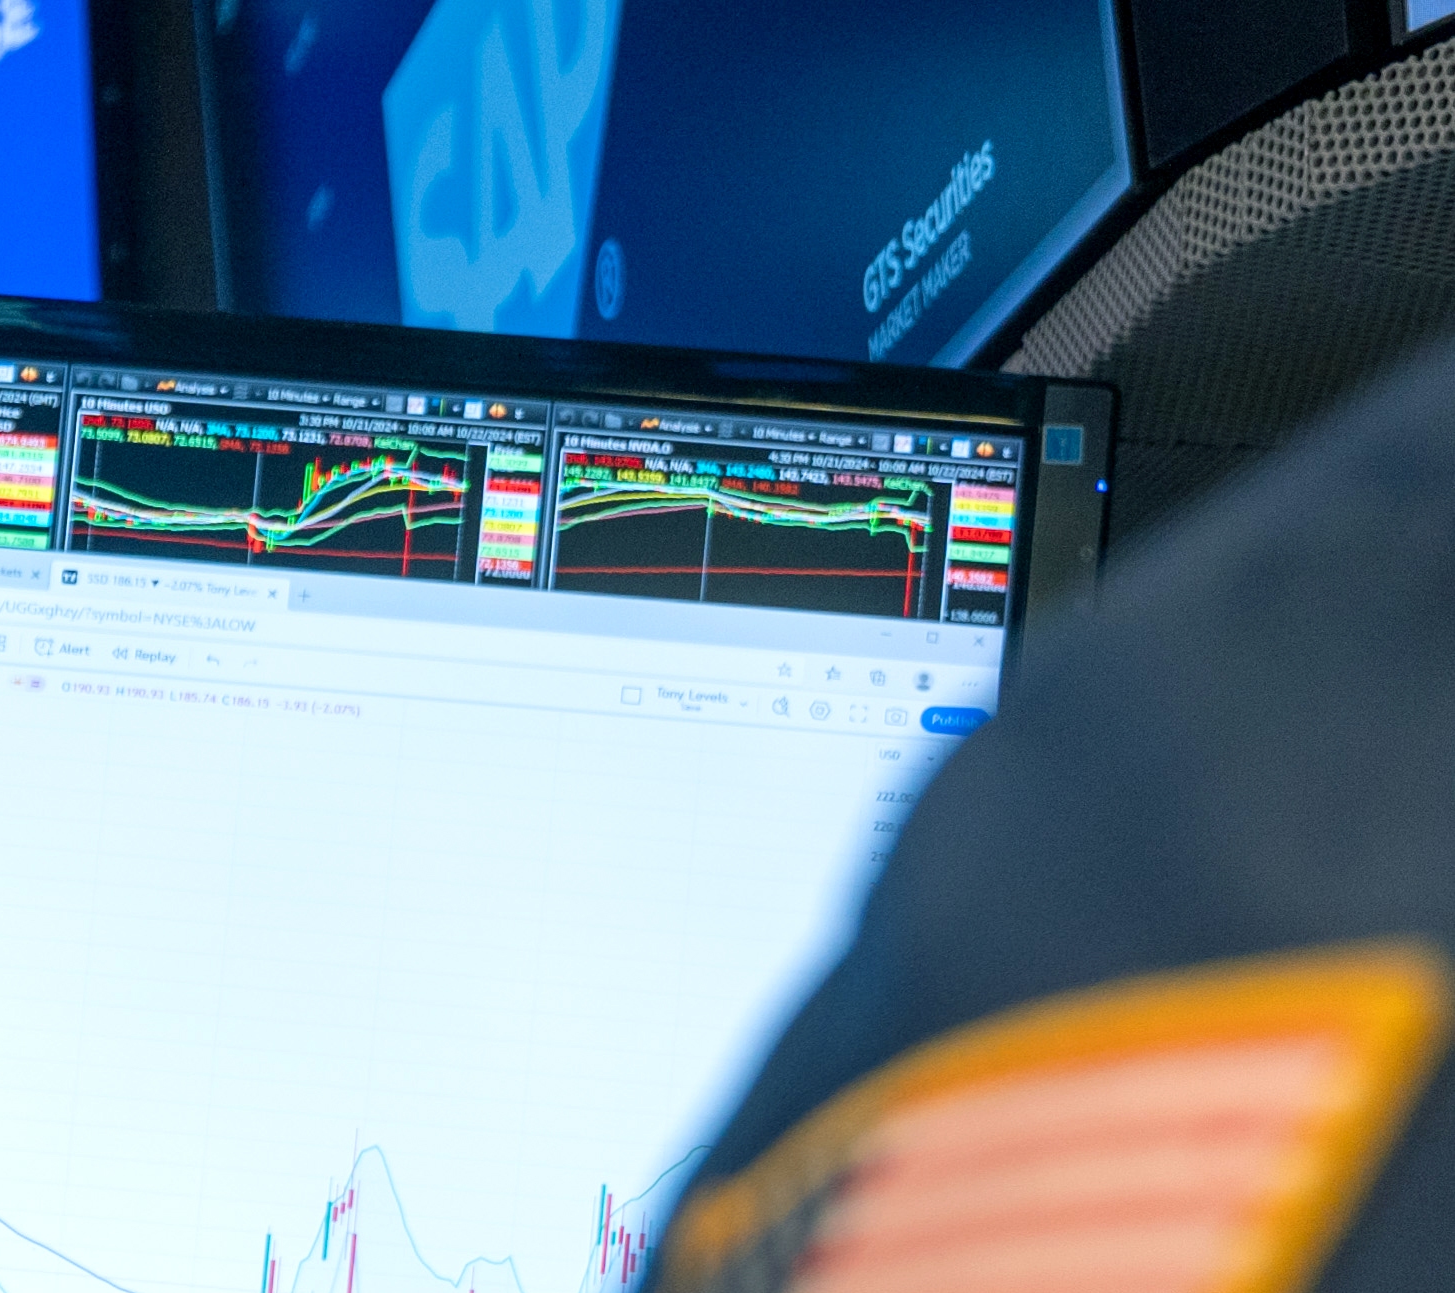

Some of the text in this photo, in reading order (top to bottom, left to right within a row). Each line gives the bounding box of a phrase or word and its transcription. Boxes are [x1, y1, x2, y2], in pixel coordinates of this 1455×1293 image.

[863, 139, 996, 313] GTS Securities
[58, 643, 91, 657] Alert
[134, 649, 176, 665] Replay
[656, 686, 729, 706] Tony Levels
